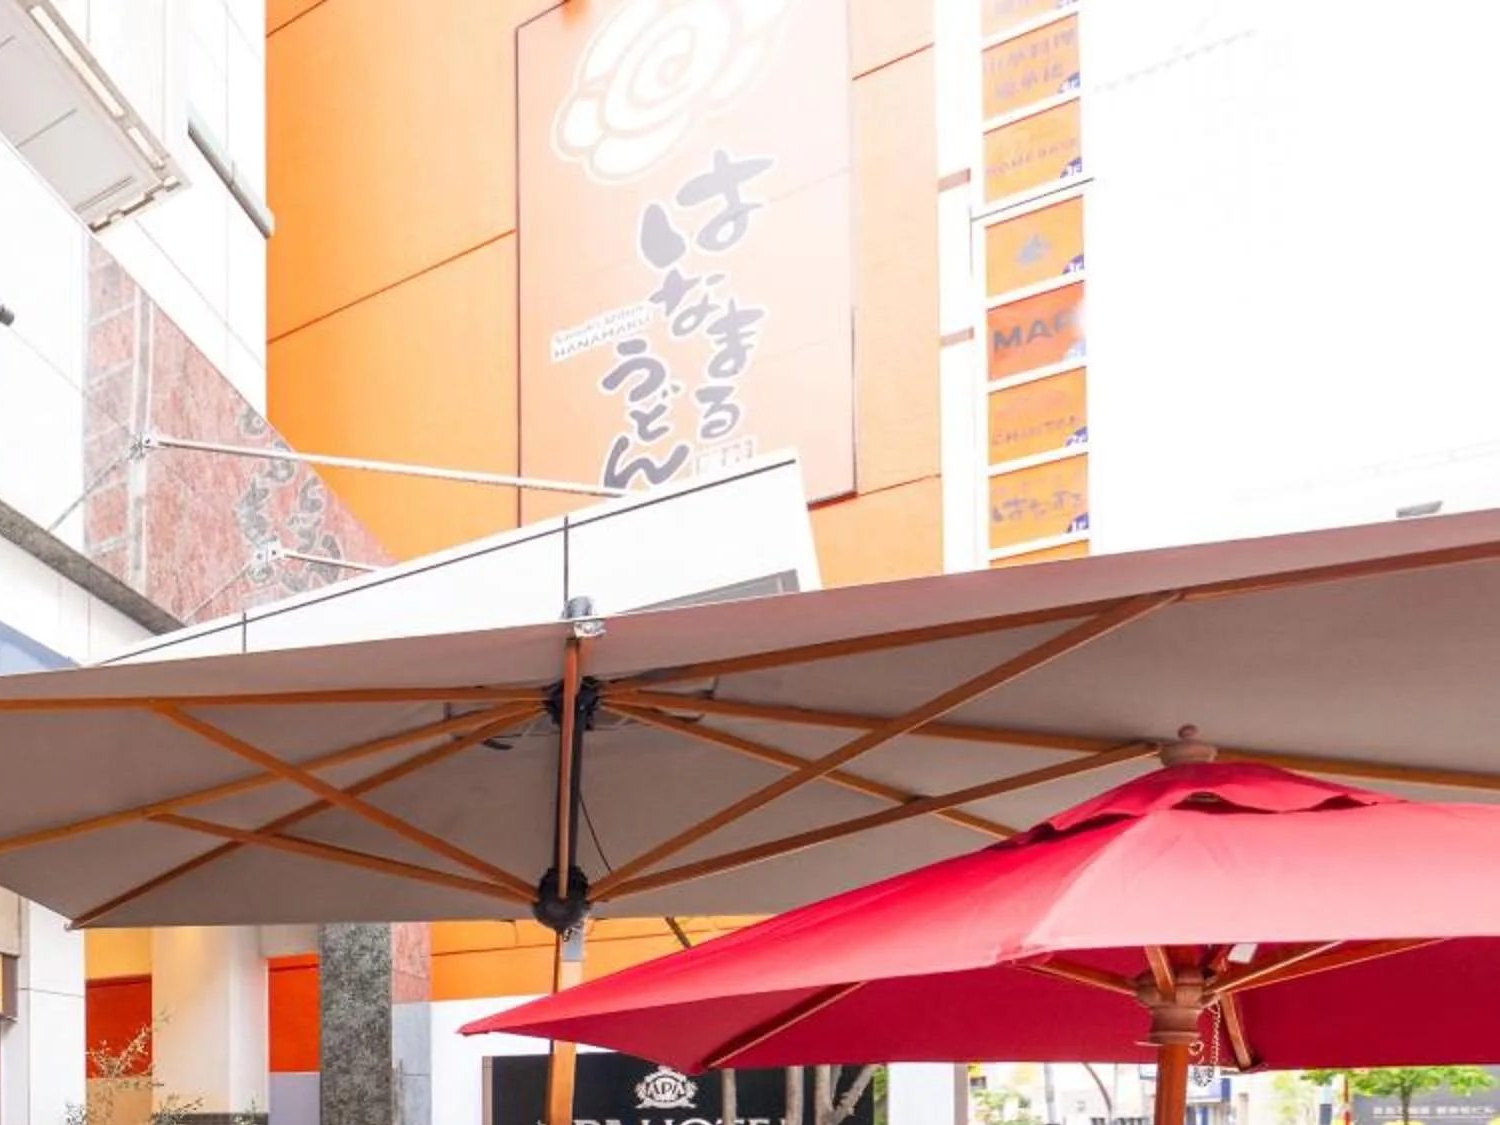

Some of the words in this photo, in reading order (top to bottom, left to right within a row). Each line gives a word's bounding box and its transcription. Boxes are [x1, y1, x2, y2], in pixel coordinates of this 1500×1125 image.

[642, 151, 773, 438] はなまる
[602, 340, 689, 488] うどん
